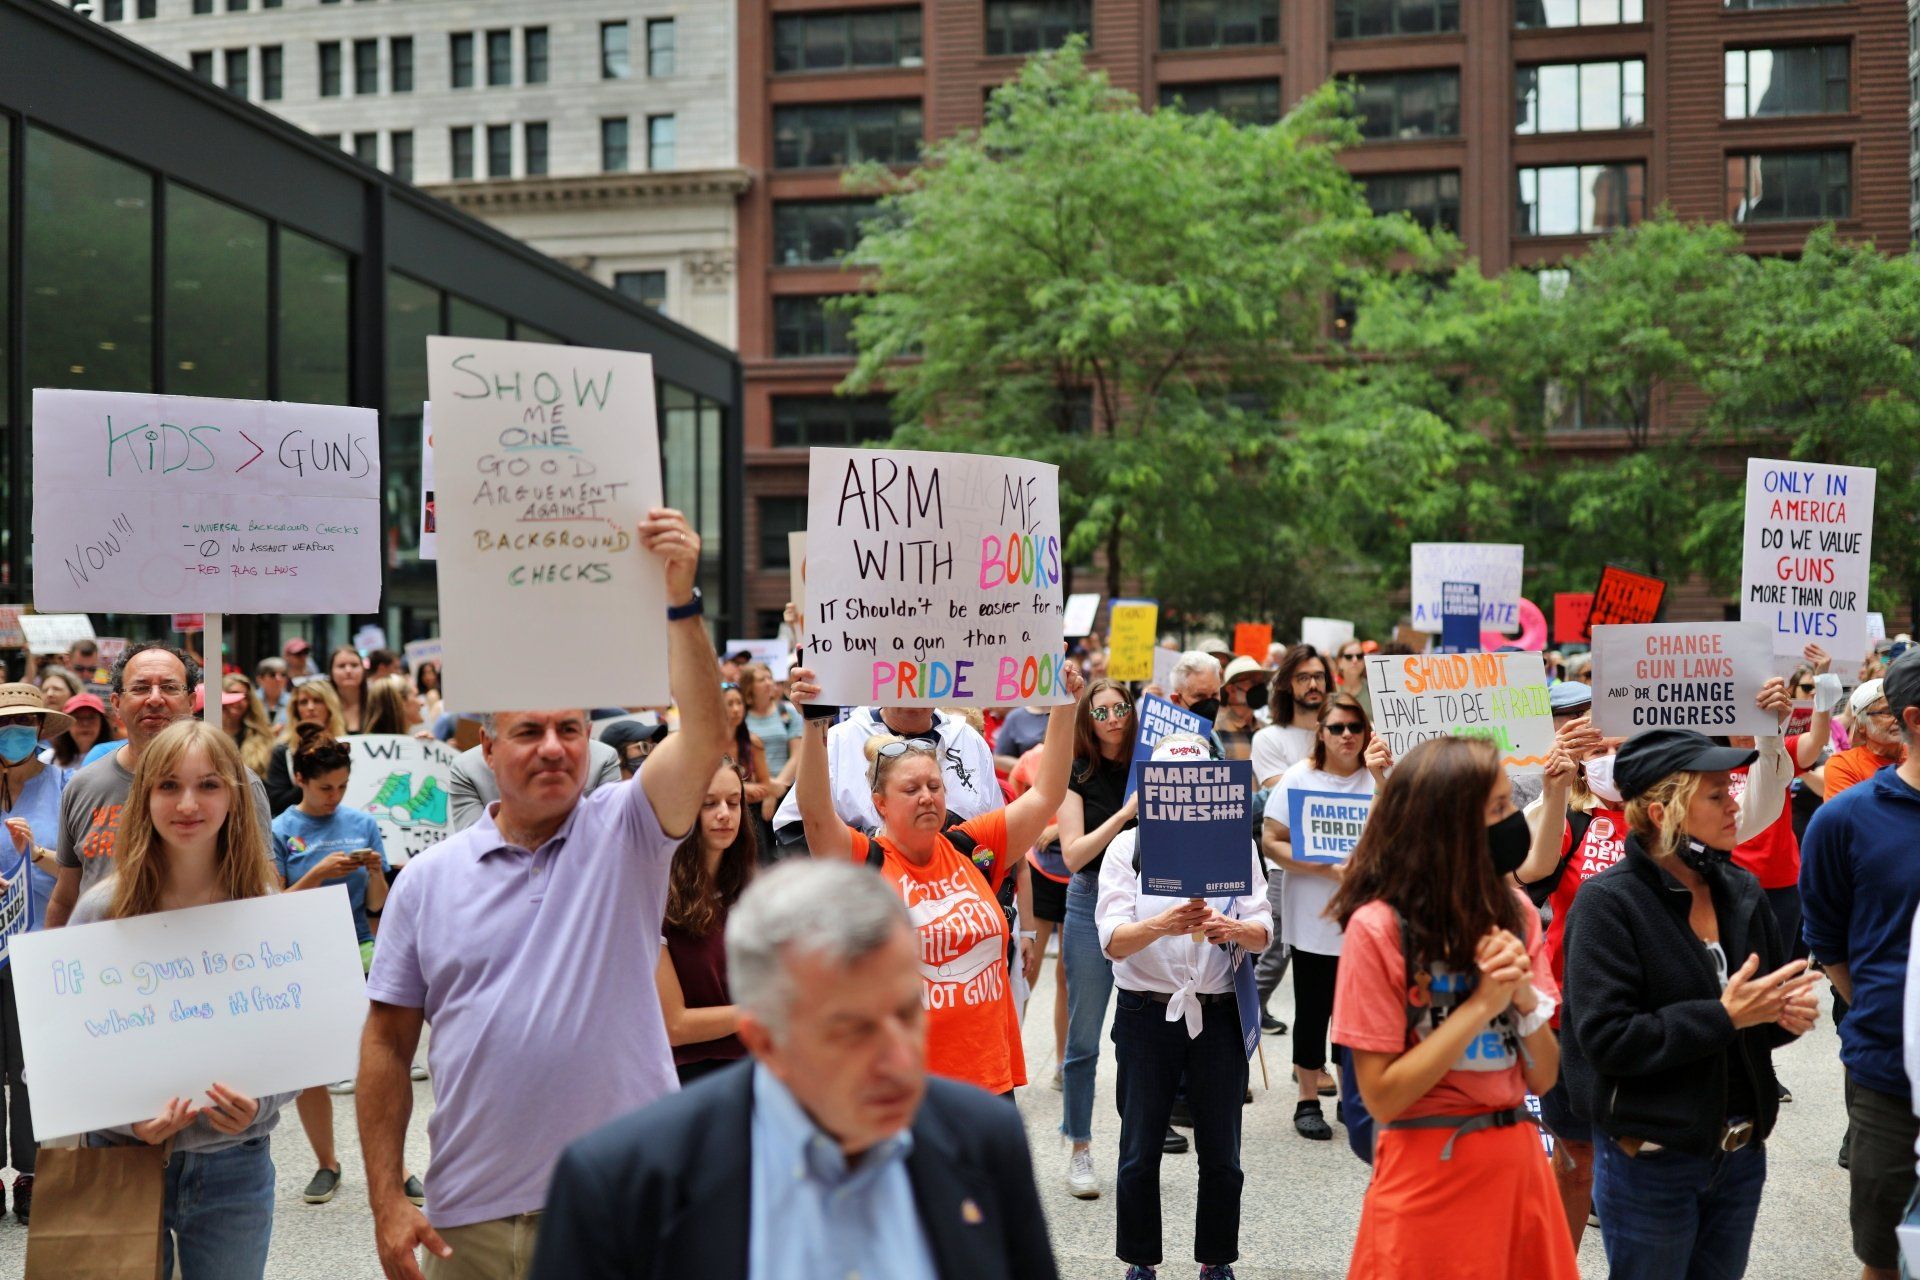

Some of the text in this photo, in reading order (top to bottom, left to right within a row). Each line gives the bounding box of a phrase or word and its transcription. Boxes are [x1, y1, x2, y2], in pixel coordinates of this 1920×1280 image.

[452, 354, 612, 410] SHOW
[524, 404, 564, 425] ME
[499, 425, 571, 447] ONE
[278, 430, 369, 478] GUNS
[477, 455, 596, 478] GOOD
[1764, 470, 1847, 496] ONLY IN
[836, 457, 1040, 534] ARM ME
[523, 499, 606, 519] AGAINST
[1771, 499, 1846, 524] AMERICA
[194, 523, 241, 533] UNIVERSAL
[64, 512, 135, 590] NOW!!!
[250, 541, 288, 553] ASSAULT
[474, 529, 631, 552] BACKGROUND
[1761, 528, 1862, 554] DO WE VALUE
[197, 564, 298, 577] RED FLAG LAWS
[853, 532, 1059, 590] WITH BOOKS
[1777, 556, 1835, 584] GUNS
[508, 563, 612, 586] CHECKS
[820, 599, 838, 623] IT
[846, 596, 932, 620] Shouldn't
[949, 599, 967, 618] be
[979, 600, 1020, 617] easier
[1032, 593, 1050, 614] for
[1751, 584, 1857, 611] MORE THAN OUR
[1778, 611, 1838, 637] LIVES
[808, 629, 1031, 662] to buy a gun than a
[1646, 634, 1723, 656] CHANGE
[872, 661, 974, 700] PRIDE
[995, 653, 1068, 701] BOOK
[1372, 653, 1509, 694] I SHOULD NOT
[1636, 658, 1734, 679] GUN LAWS
[1608, 686, 1629, 698] AND
[1657, 682, 1735, 703] CHANGE
[1146, 699, 1200, 734] MARCH
[1380, 686, 1551, 729] HAVE TO BE AFRAID
[1632, 705, 1736, 725] CONGRESS
[1143, 713, 1175, 737] FOR
[1144, 767, 1231, 784] MARCH
[1145, 784, 1245, 803] FOR OUR
[93, 804, 124, 828] WE
[1146, 803, 1212, 822] LIVES
[1311, 804, 1369, 820] MARCH
[1312, 820, 1344, 835] FOR
[1206, 881, 1246, 891] GIFFORDS
[100, 967, 122, 985] a
[132, 956, 195, 996] gun
[201, 950, 228, 976] is
[231, 953, 255, 971] a
[260, 941, 303, 969] tool
[964, 962, 1003, 1006] GUNS
[85, 982, 301, 1038] what does it fix?
